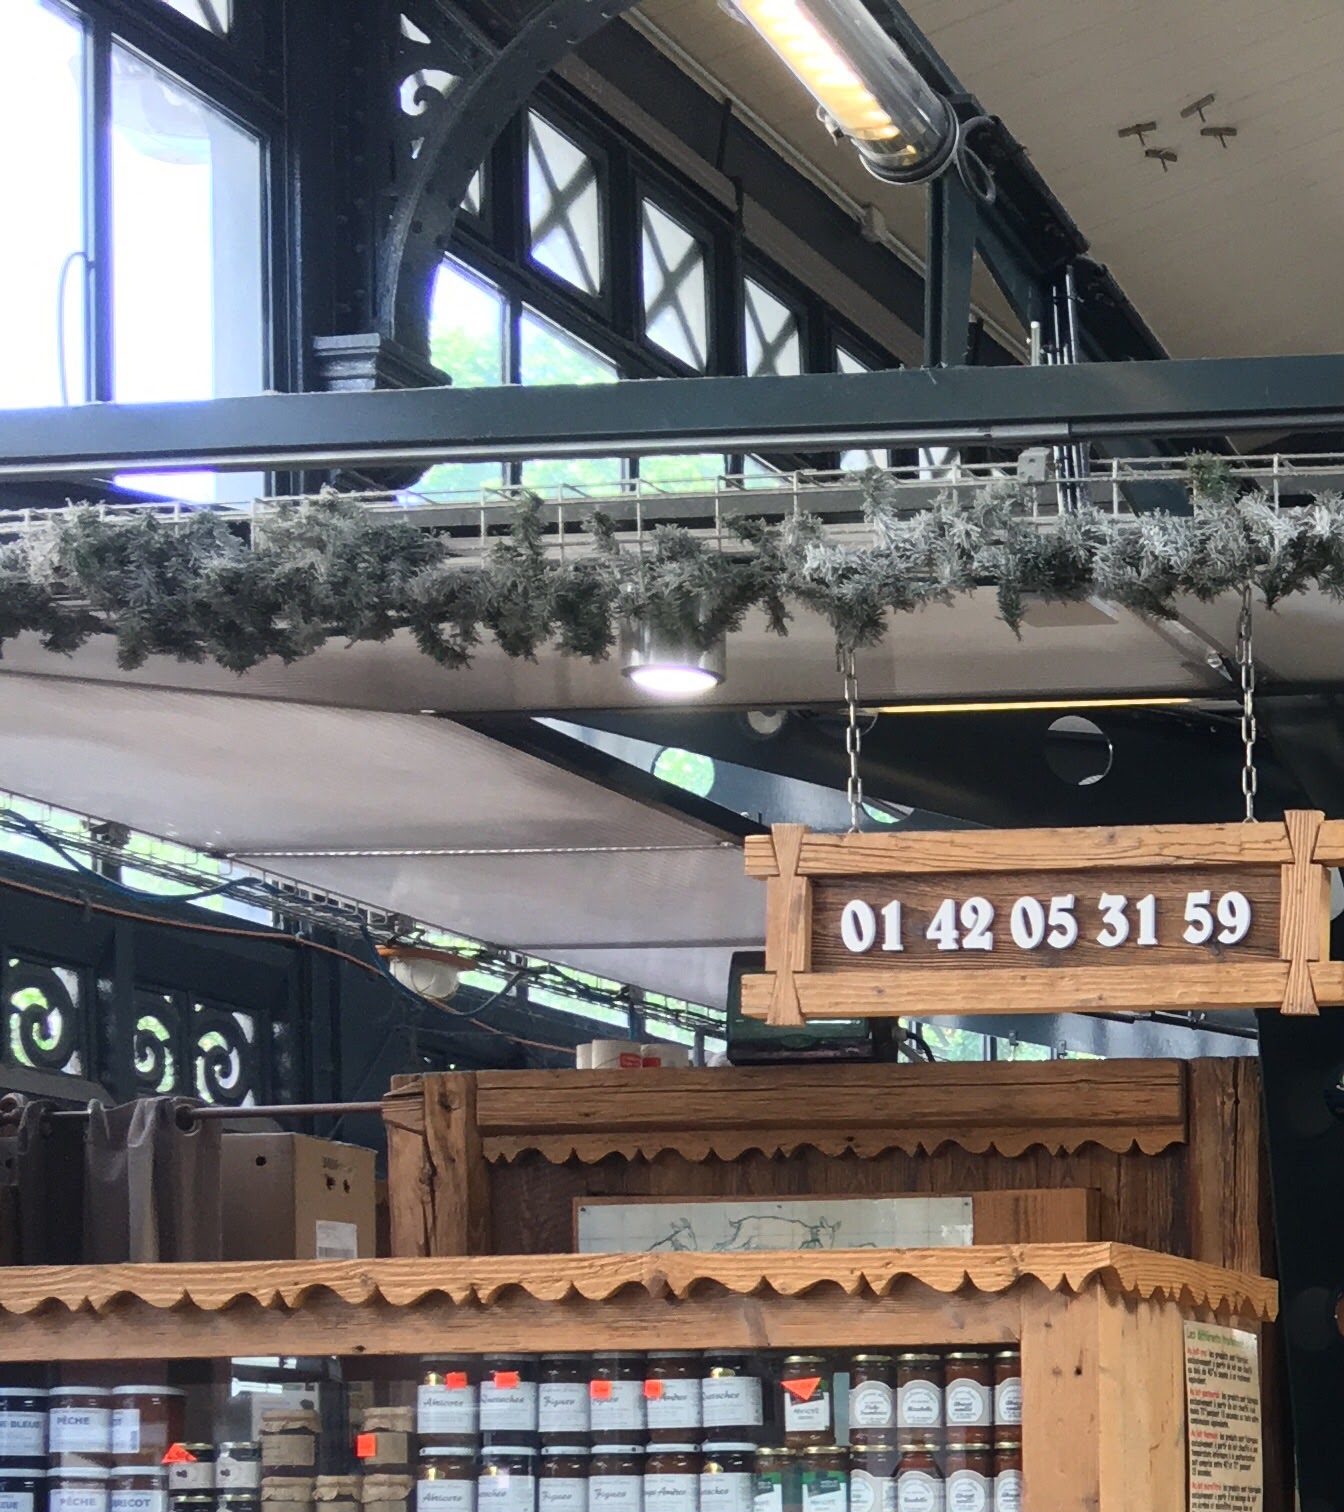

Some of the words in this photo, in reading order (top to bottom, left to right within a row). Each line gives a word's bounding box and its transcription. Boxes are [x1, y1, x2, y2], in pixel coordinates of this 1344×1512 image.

[840, 897, 904, 954] 01
[925, 896, 995, 952] 42
[1010, 893, 1079, 950] 05
[1096, 891, 1158, 947] 31
[1182, 889, 1251, 945] 59
